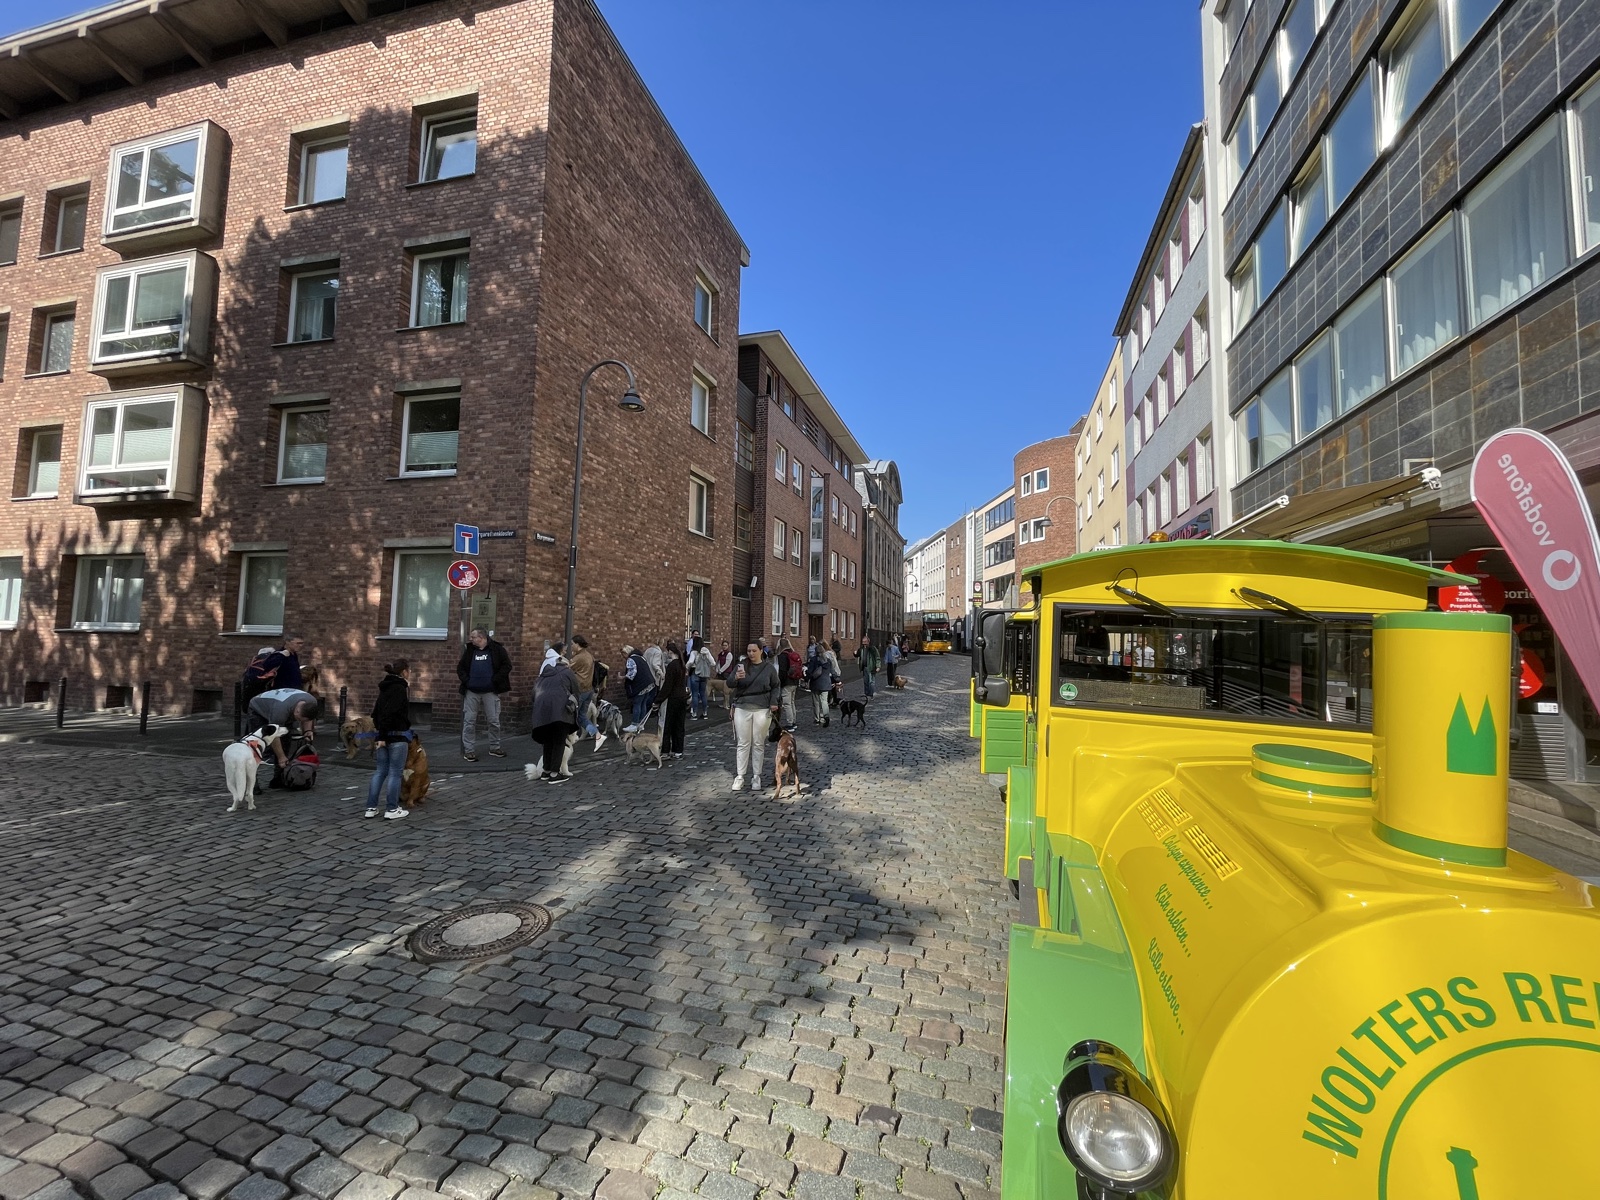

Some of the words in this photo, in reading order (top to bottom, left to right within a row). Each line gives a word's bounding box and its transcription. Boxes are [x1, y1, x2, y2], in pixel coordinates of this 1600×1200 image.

[1390, 536, 1411, 548] Karten
[1162, 834, 1185, 862] Cologne
[1155, 883, 1173, 912] Köln
[1147, 937, 1164, 975] Kölle
[1302, 976, 1497, 1160] WOLTERS
[1502, 971, 1600, 1030] RE
